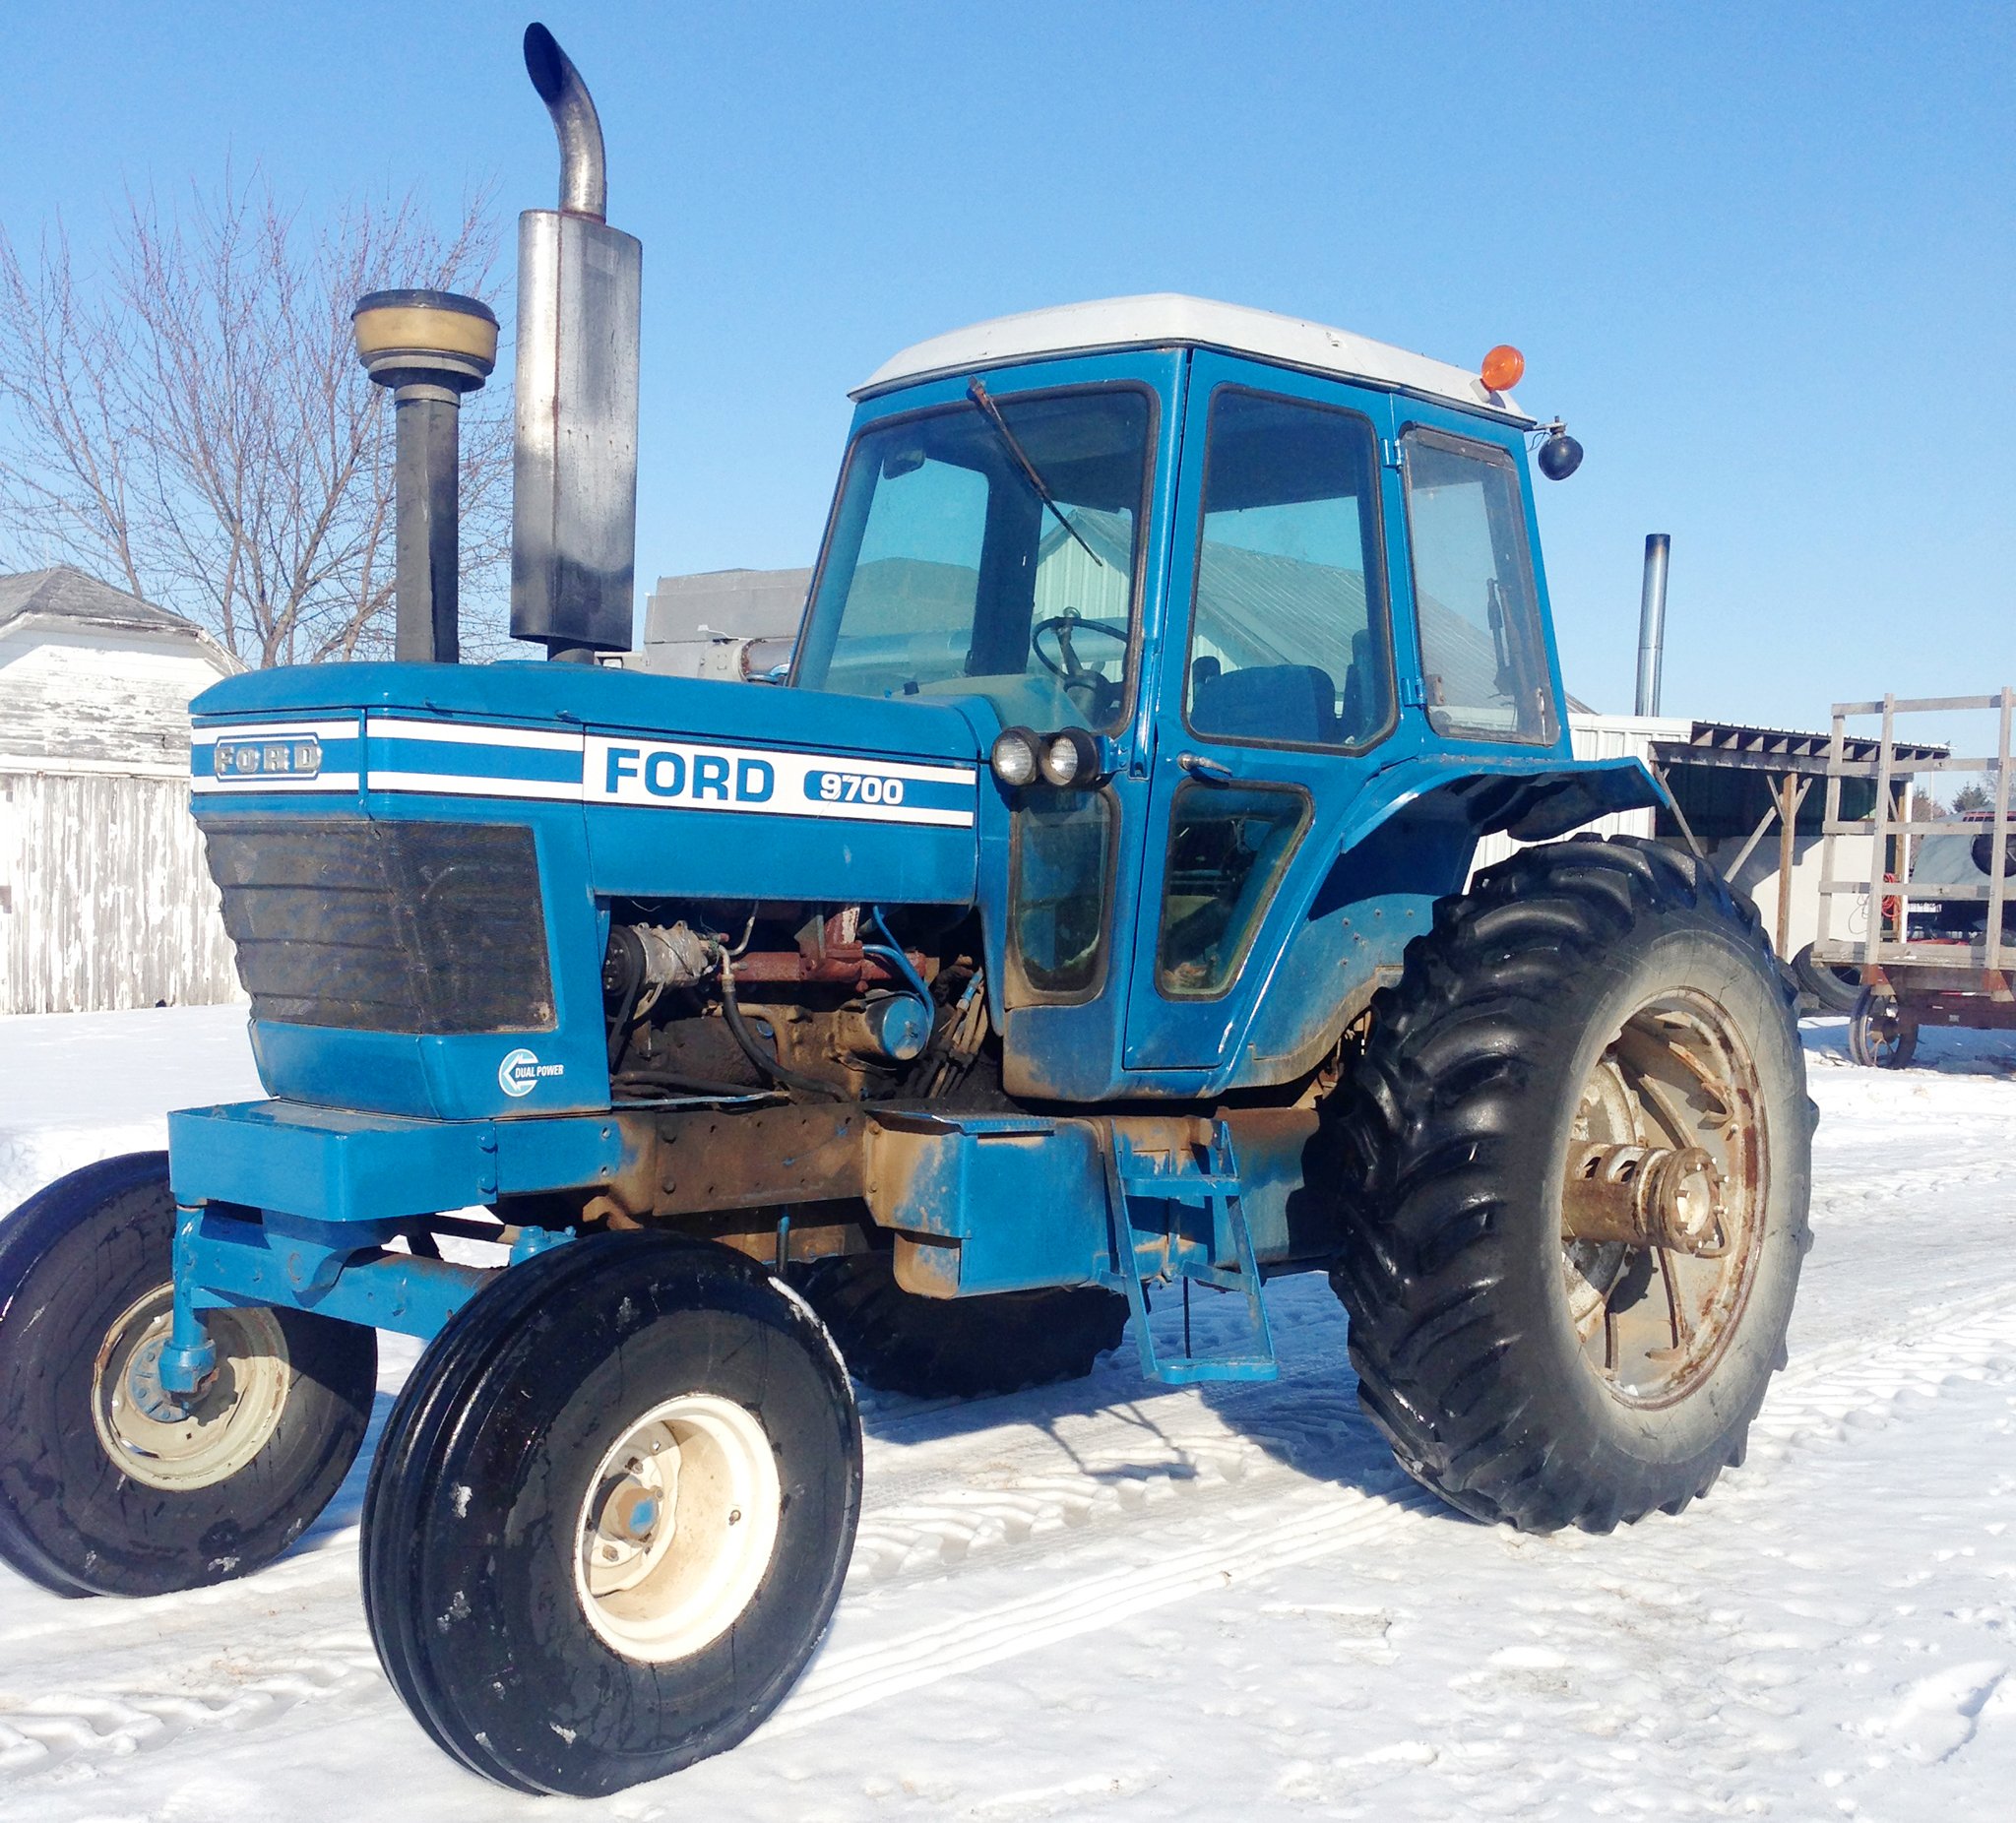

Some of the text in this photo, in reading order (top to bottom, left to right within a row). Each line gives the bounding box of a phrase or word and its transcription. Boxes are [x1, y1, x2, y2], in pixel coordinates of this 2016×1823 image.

[215, 744, 323, 774] FORD
[605, 747, 904, 805] FORD 9700
[515, 1064, 564, 1079] DUAL POWER
